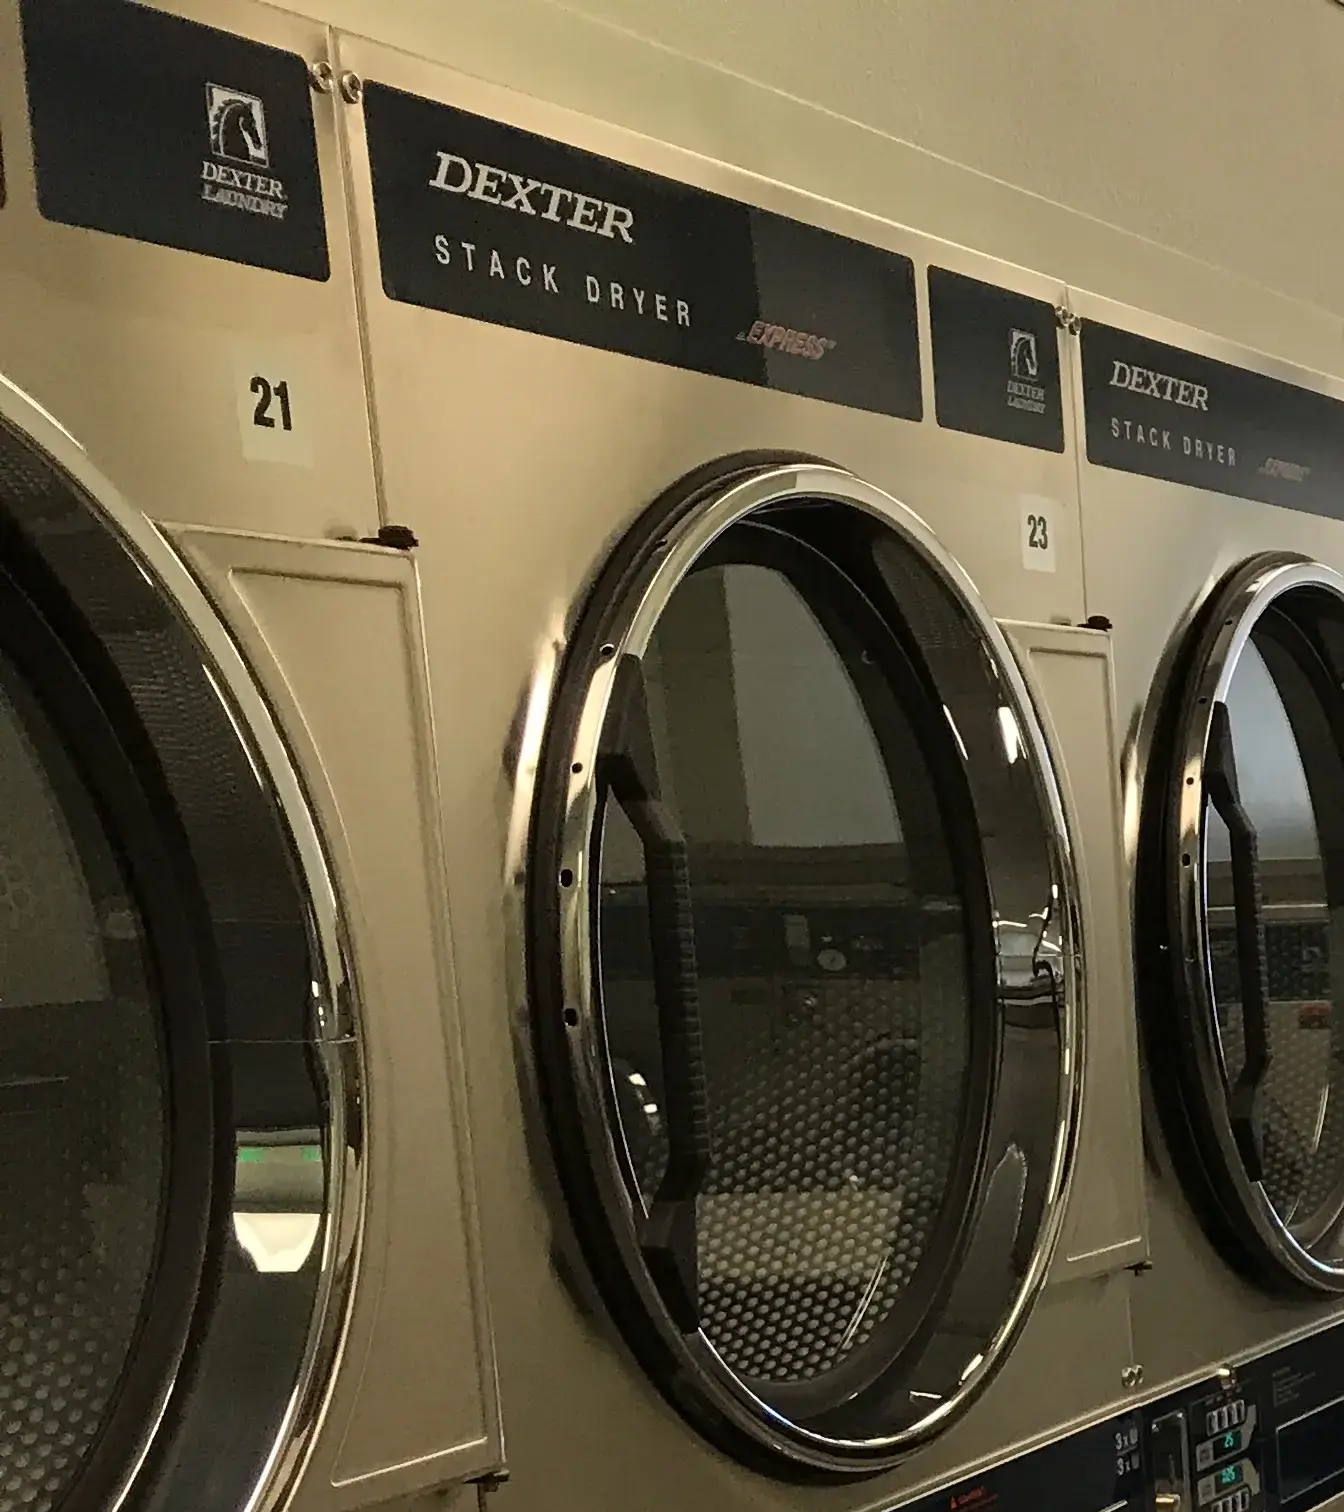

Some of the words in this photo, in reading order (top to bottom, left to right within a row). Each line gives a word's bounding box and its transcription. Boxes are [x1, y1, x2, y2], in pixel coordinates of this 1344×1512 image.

[201, 160, 284, 200] DEXTER
[428, 151, 635, 244] DEXTER
[434, 234, 559, 293] STACK
[586, 275, 690, 327] DRYER
[249, 375, 293, 432] 21
[1109, 360, 1209, 412] DEXTER
[1111, 417, 1171, 450] STACK
[1182, 435, 1237, 467] DRYER
[1027, 514, 1048, 550] 23
[1115, 1431, 1123, 1451] 3
[1116, 1457, 1125, 1477] 3
